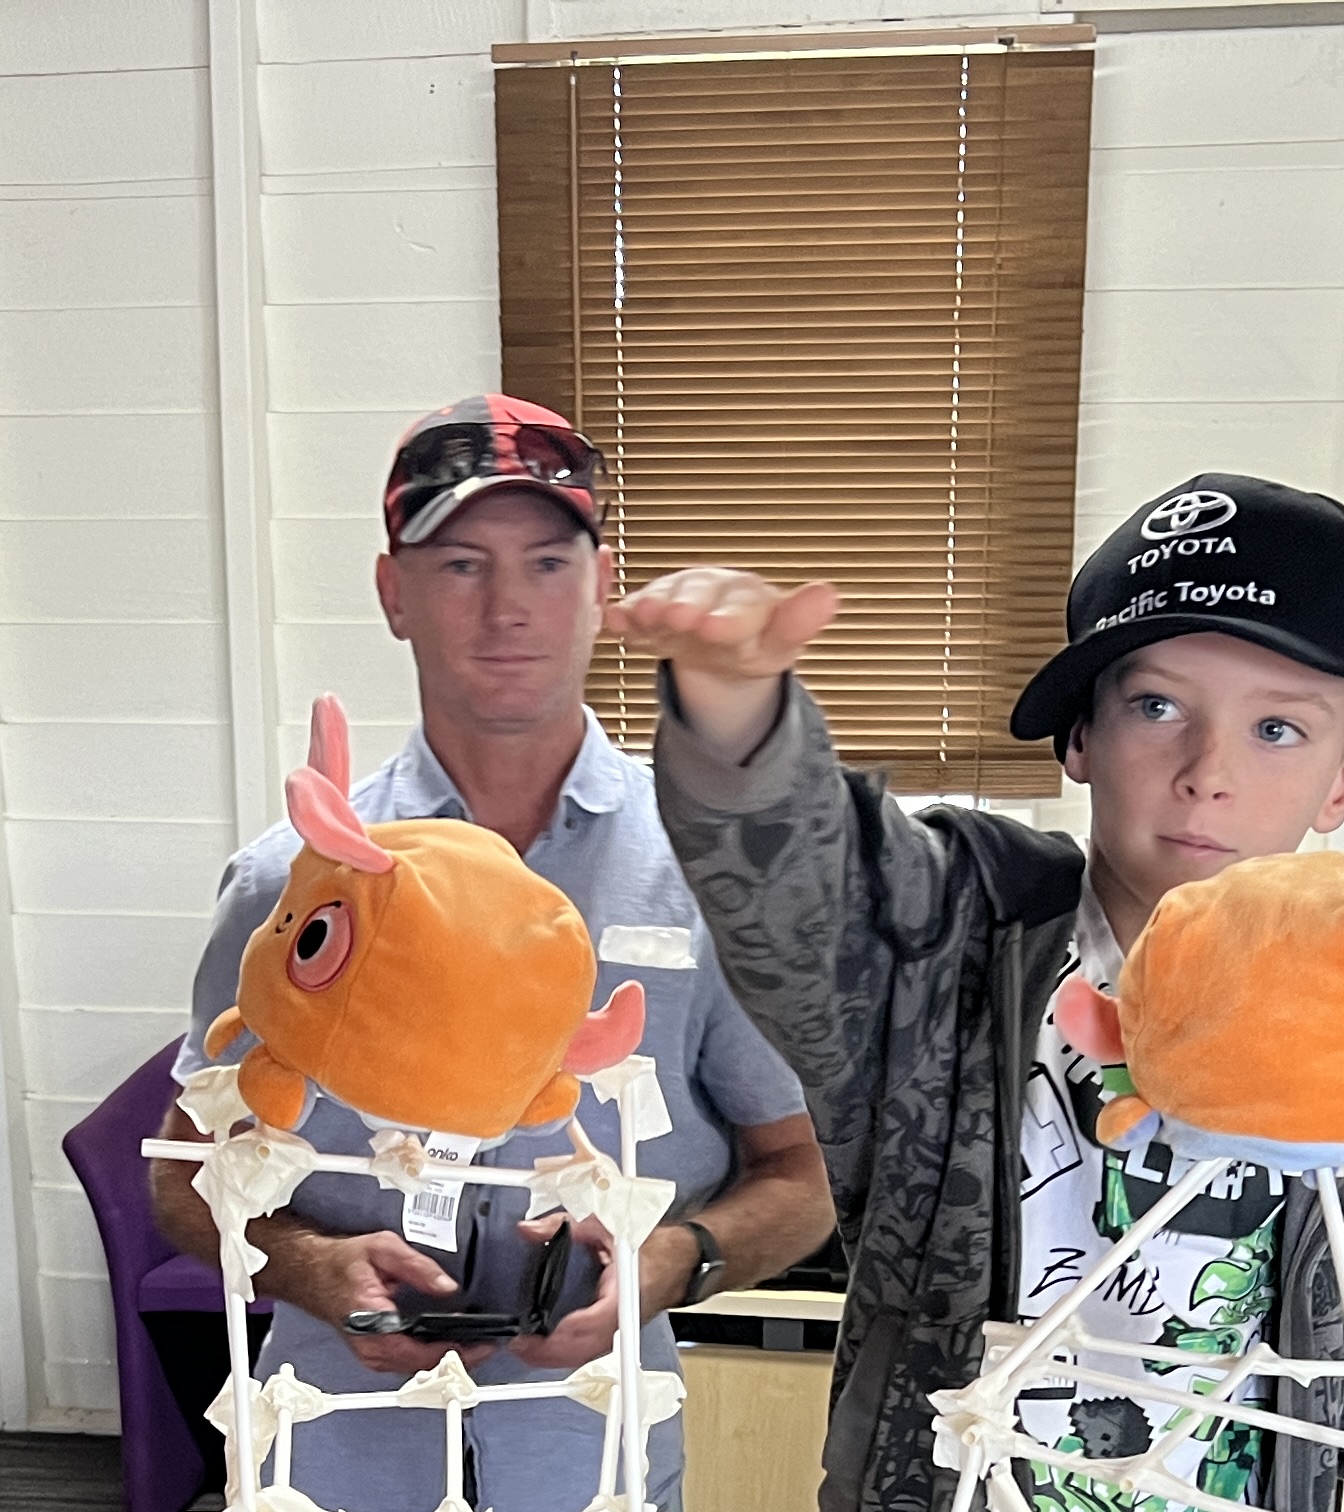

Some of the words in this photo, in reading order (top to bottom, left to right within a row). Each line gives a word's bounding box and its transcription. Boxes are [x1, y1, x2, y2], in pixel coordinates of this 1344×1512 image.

[1127, 536, 1237, 574] TOYOTA
[1095, 588, 1169, 632] Pacific
[1172, 580, 1277, 606] Toyota
[427, 1147, 459, 1162] anko
